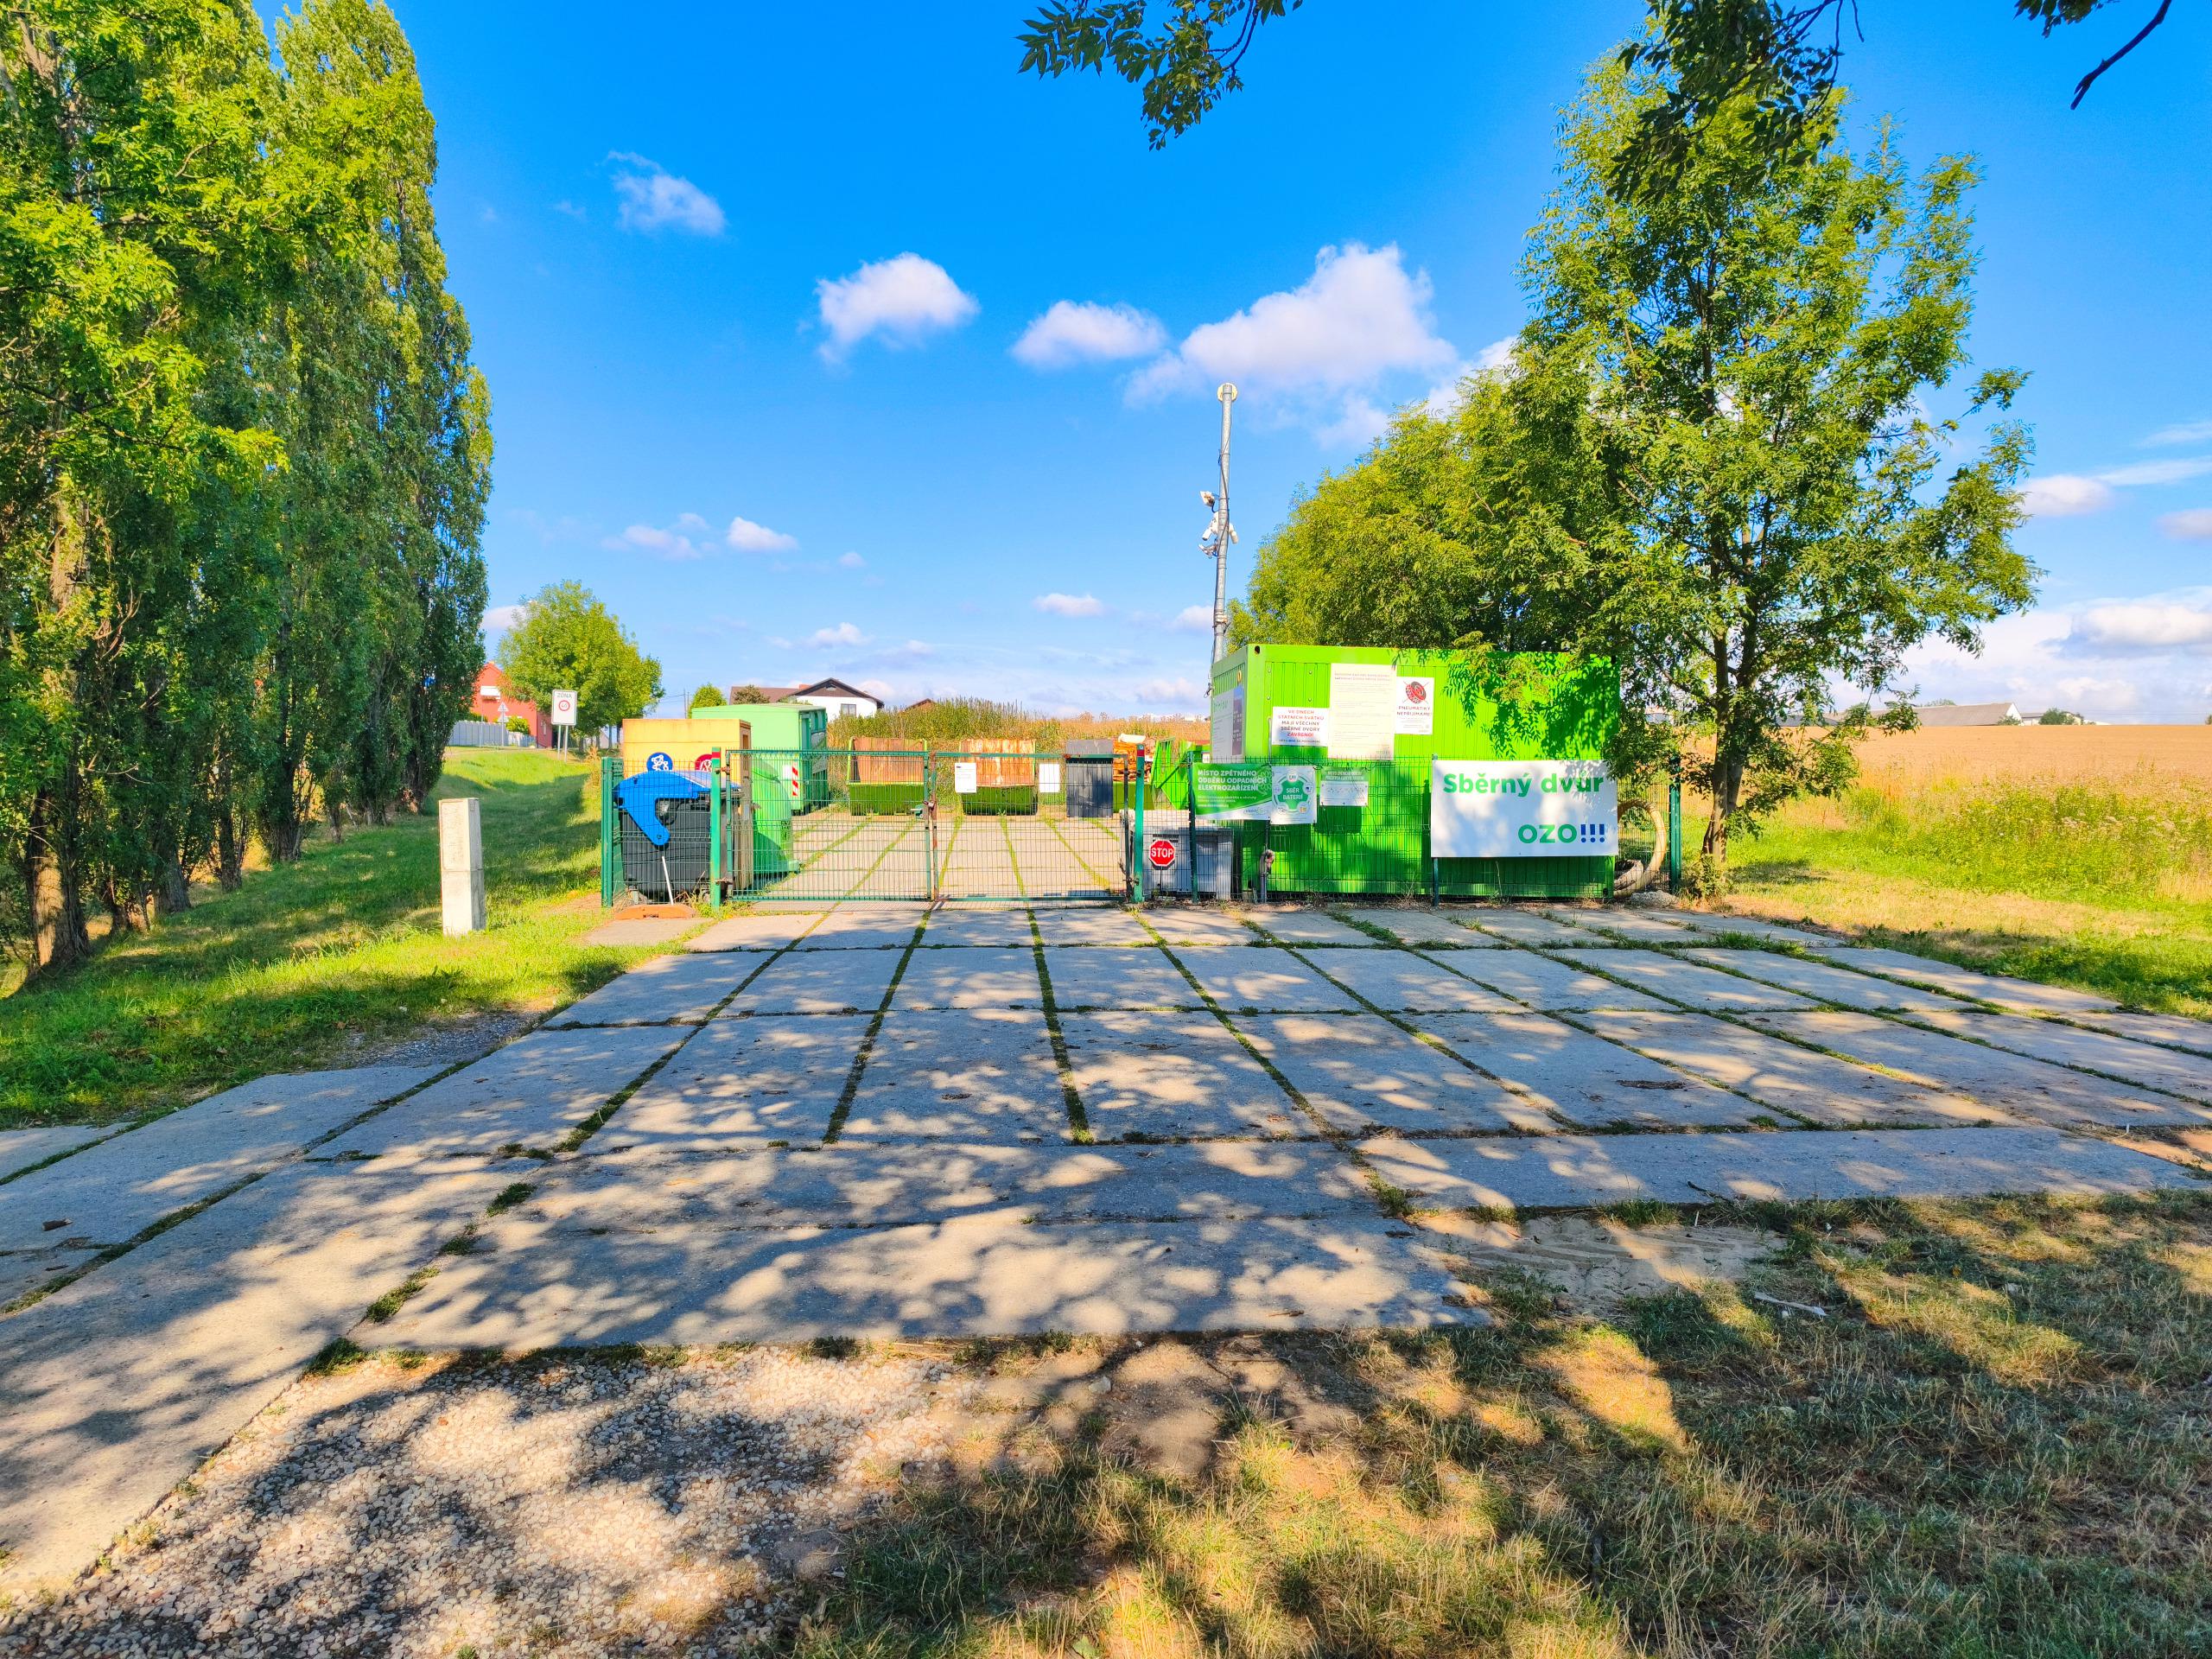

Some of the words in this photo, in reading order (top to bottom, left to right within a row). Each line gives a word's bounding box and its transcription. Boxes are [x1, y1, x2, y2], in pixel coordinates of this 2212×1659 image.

[1443, 772, 1533, 798] Sběrný
[1541, 770, 1604, 793] dvůr
[1151, 847, 1174, 858] STOP
